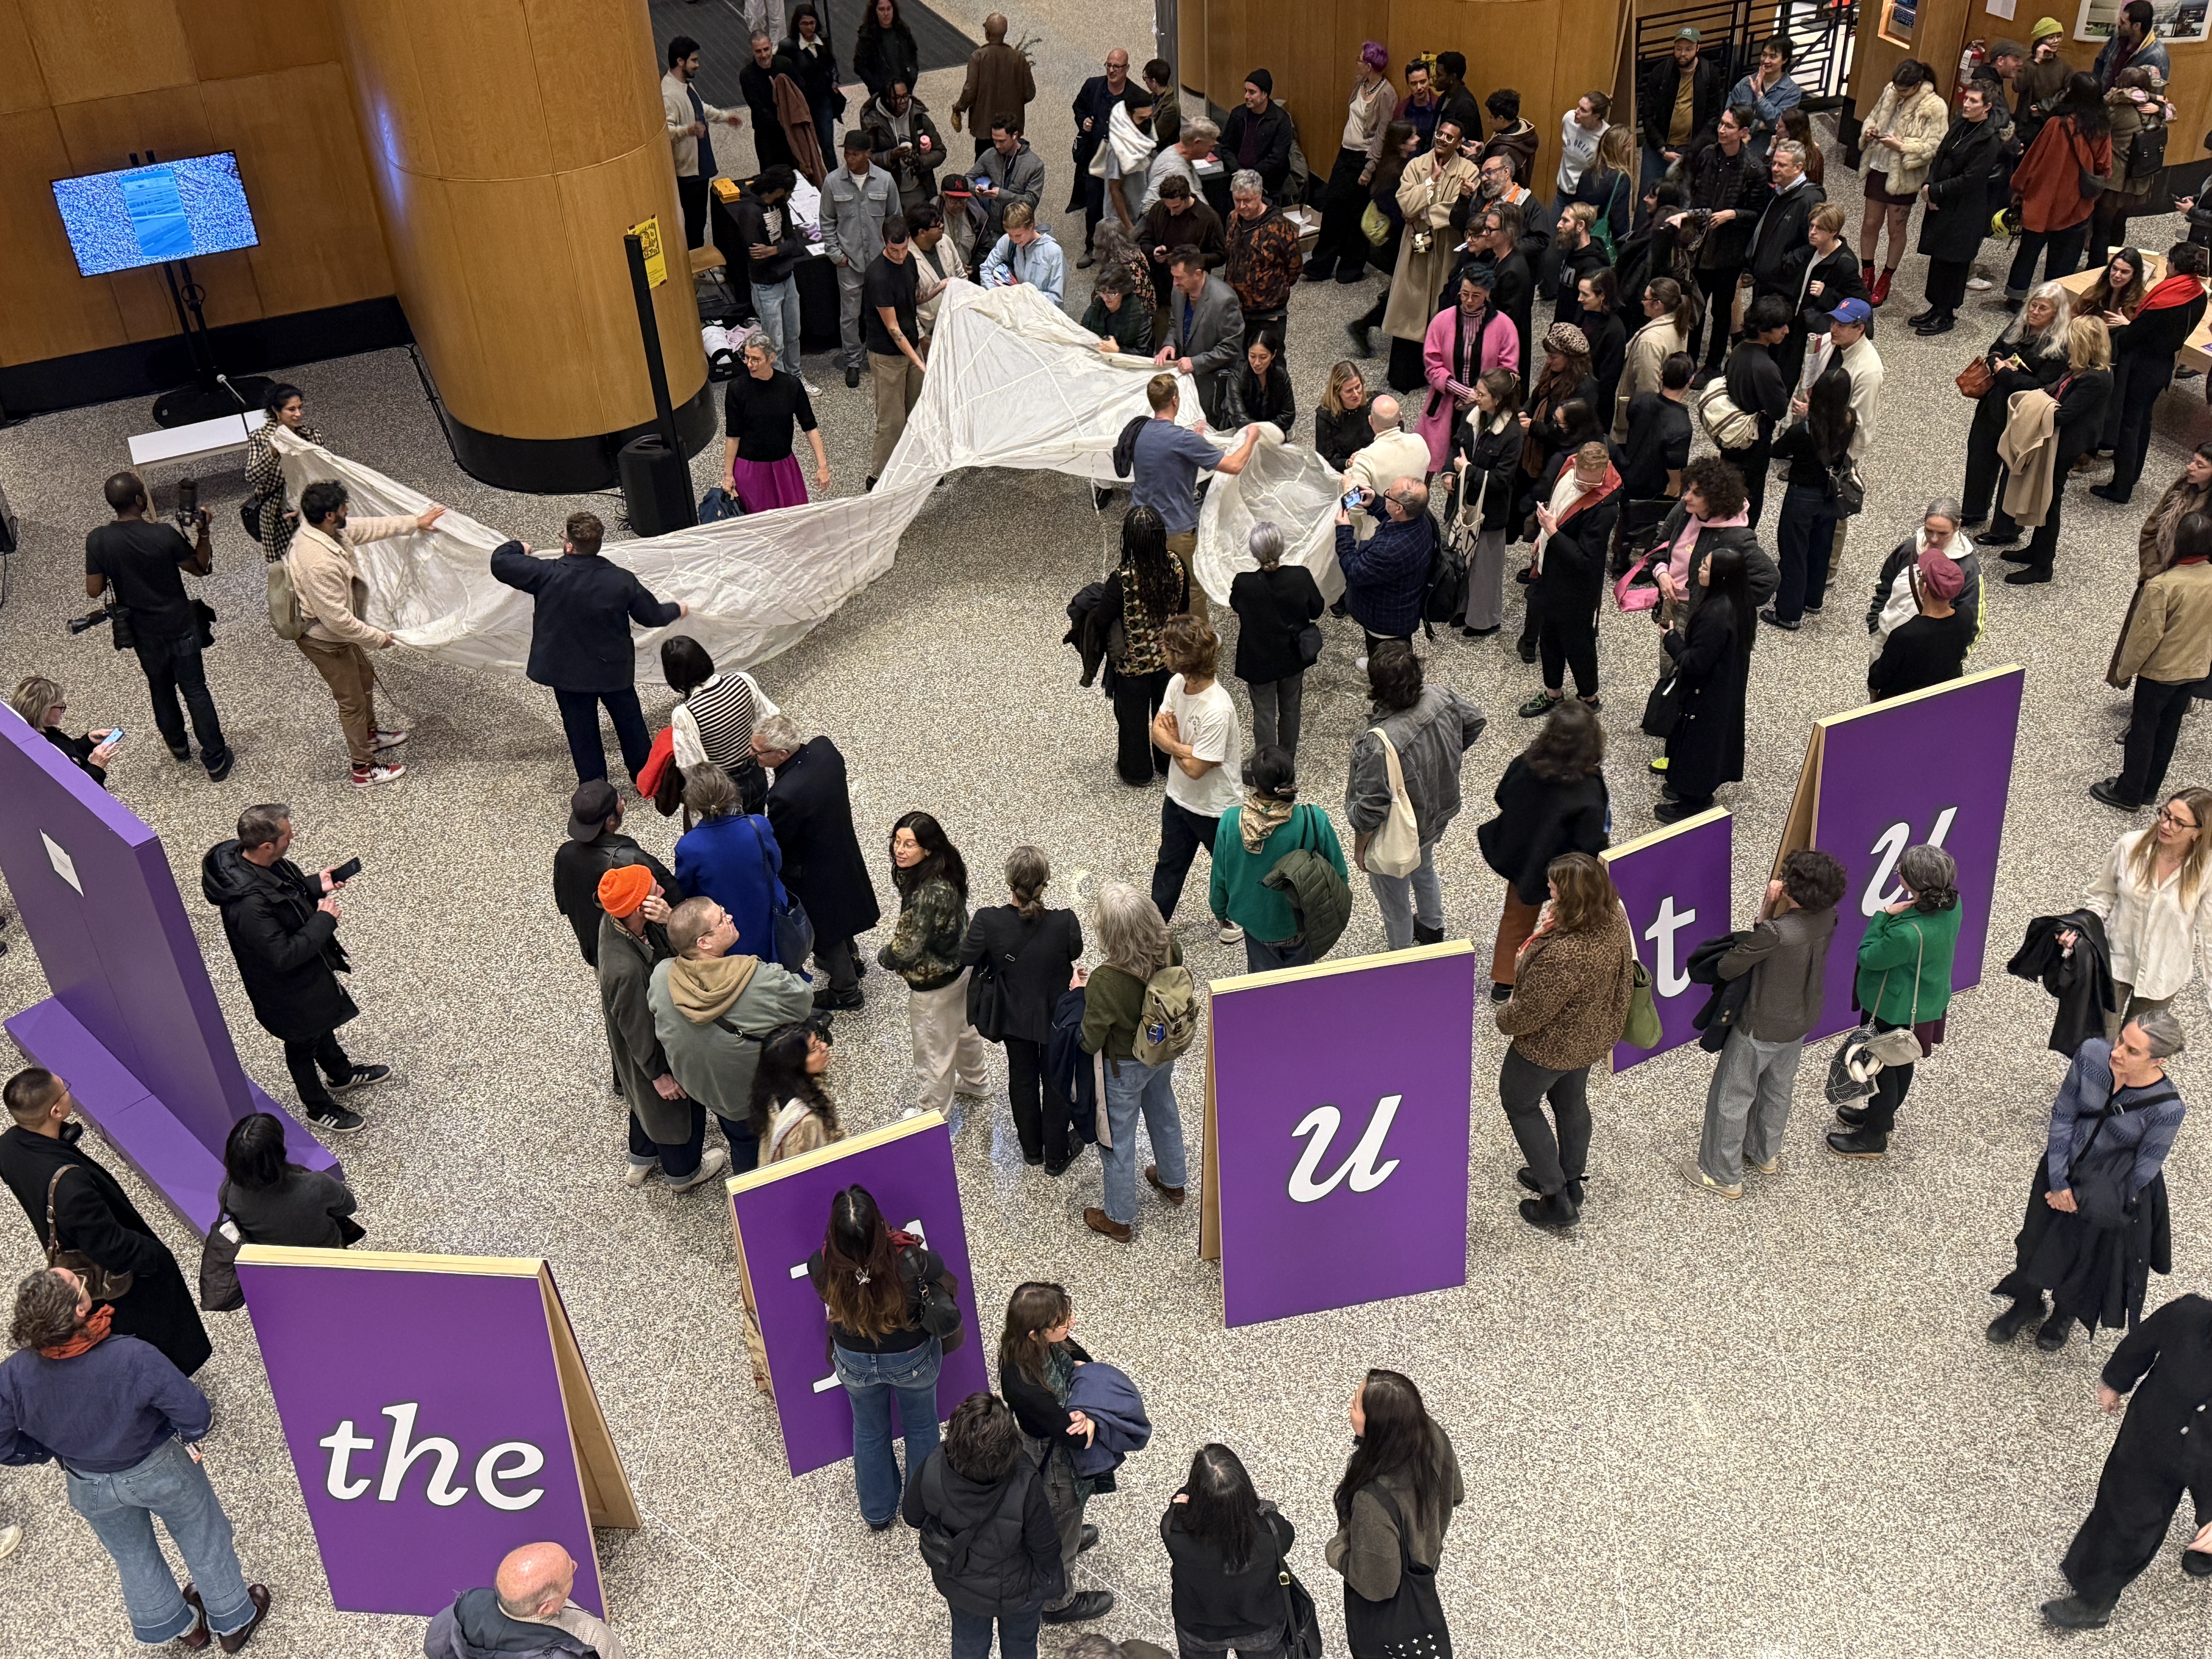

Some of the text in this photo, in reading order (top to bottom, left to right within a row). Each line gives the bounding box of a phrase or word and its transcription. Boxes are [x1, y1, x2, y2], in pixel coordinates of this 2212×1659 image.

[1645, 895, 1696, 998] t
[1288, 1094, 1402, 1202] u
[319, 1402, 545, 1510] the
